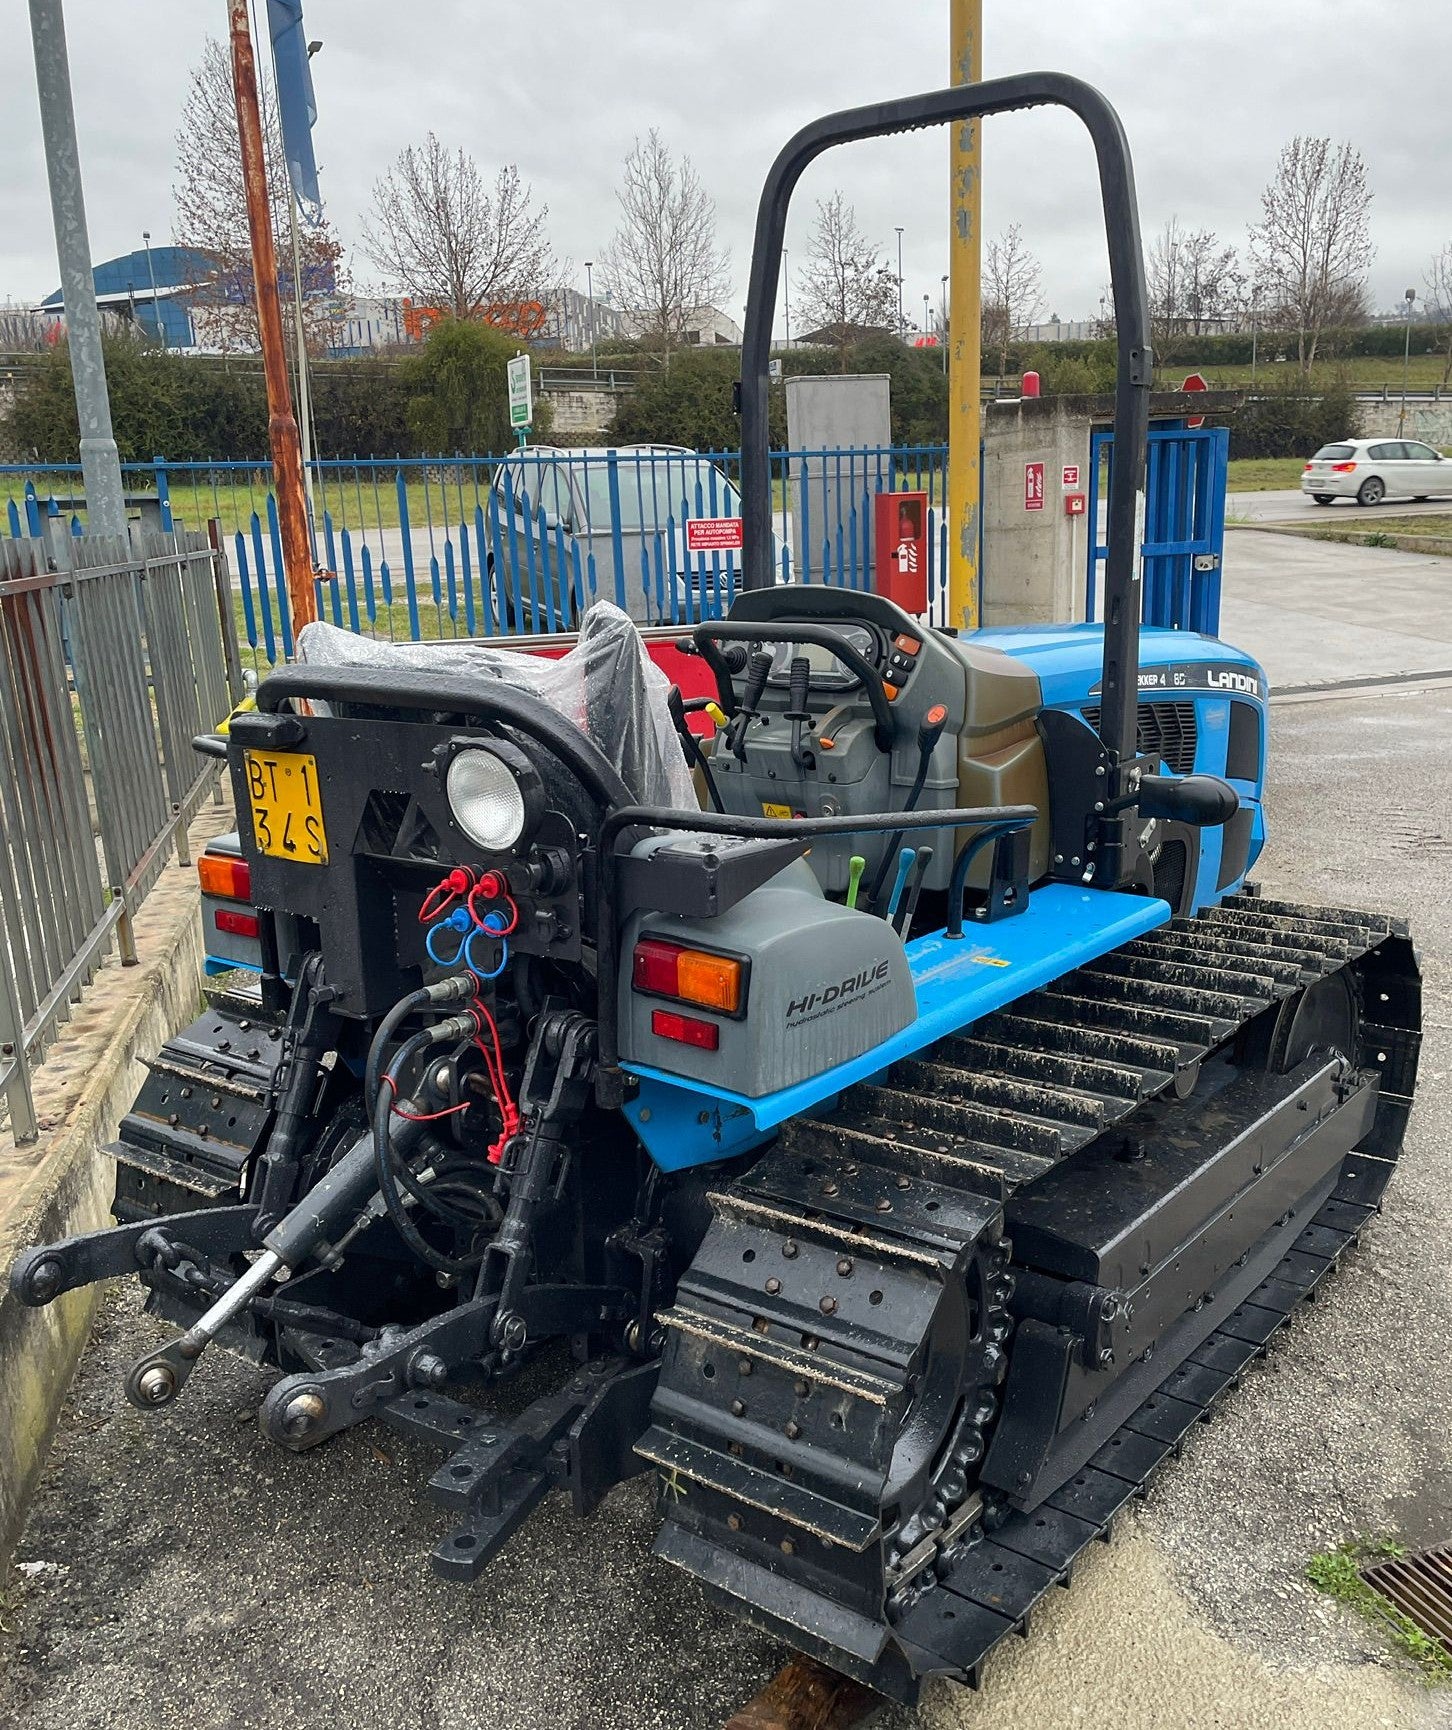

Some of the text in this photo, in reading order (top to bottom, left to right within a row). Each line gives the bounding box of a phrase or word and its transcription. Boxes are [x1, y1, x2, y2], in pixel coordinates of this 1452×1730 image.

[1207, 670, 1258, 694] LANDINI
[249, 759, 278, 803] BT
[786, 959, 889, 1018] HI-DRIVE
